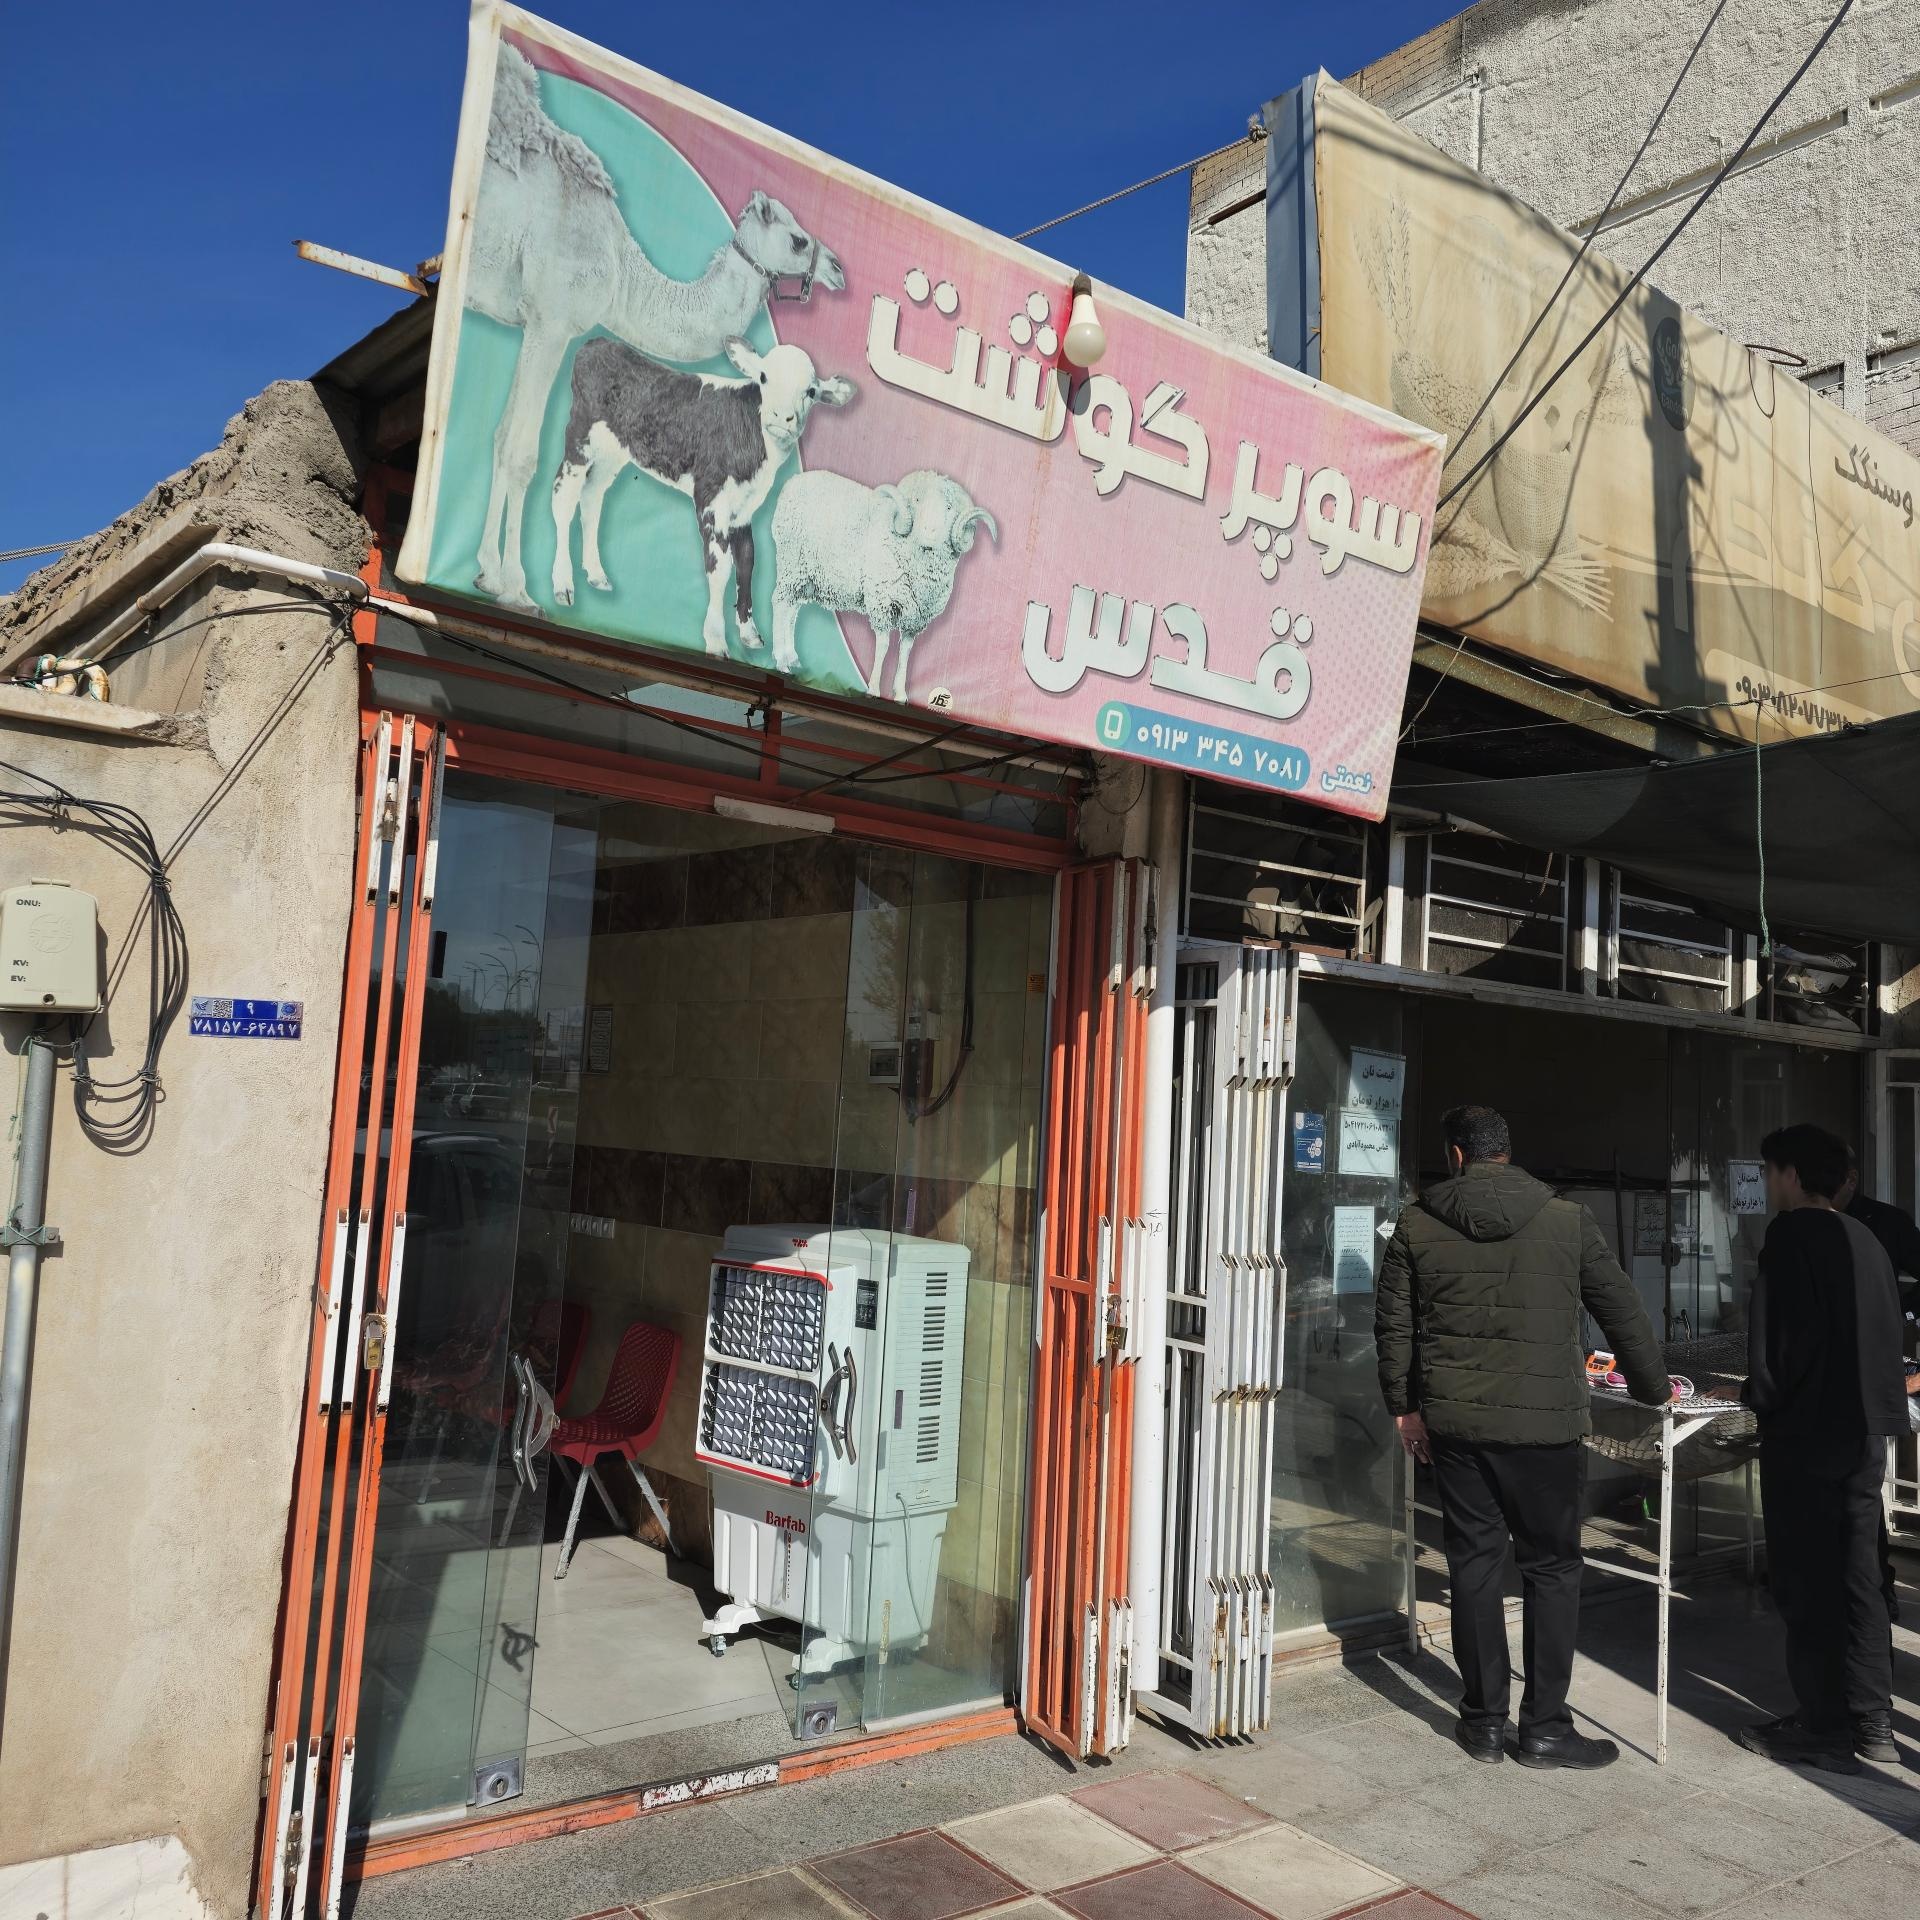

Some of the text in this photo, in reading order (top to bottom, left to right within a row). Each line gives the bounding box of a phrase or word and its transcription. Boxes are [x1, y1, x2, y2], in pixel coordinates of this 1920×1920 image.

[866, 267, 1423, 580] سوپر گوشت
[1022, 584, 1313, 721] قدس
[1137, 724, 1301, 781] ۰۹۱۳ ۳۴۵ ۷۰۸۱
[1321, 765, 1372, 794] نعمتی
[16, 899, 41, 907] ONU:
[247, 1002, 254, 1015] ۹
[1363, 1064, 1395, 1082] قیمت نان
[765, 1510, 806, 1534] Barfab
